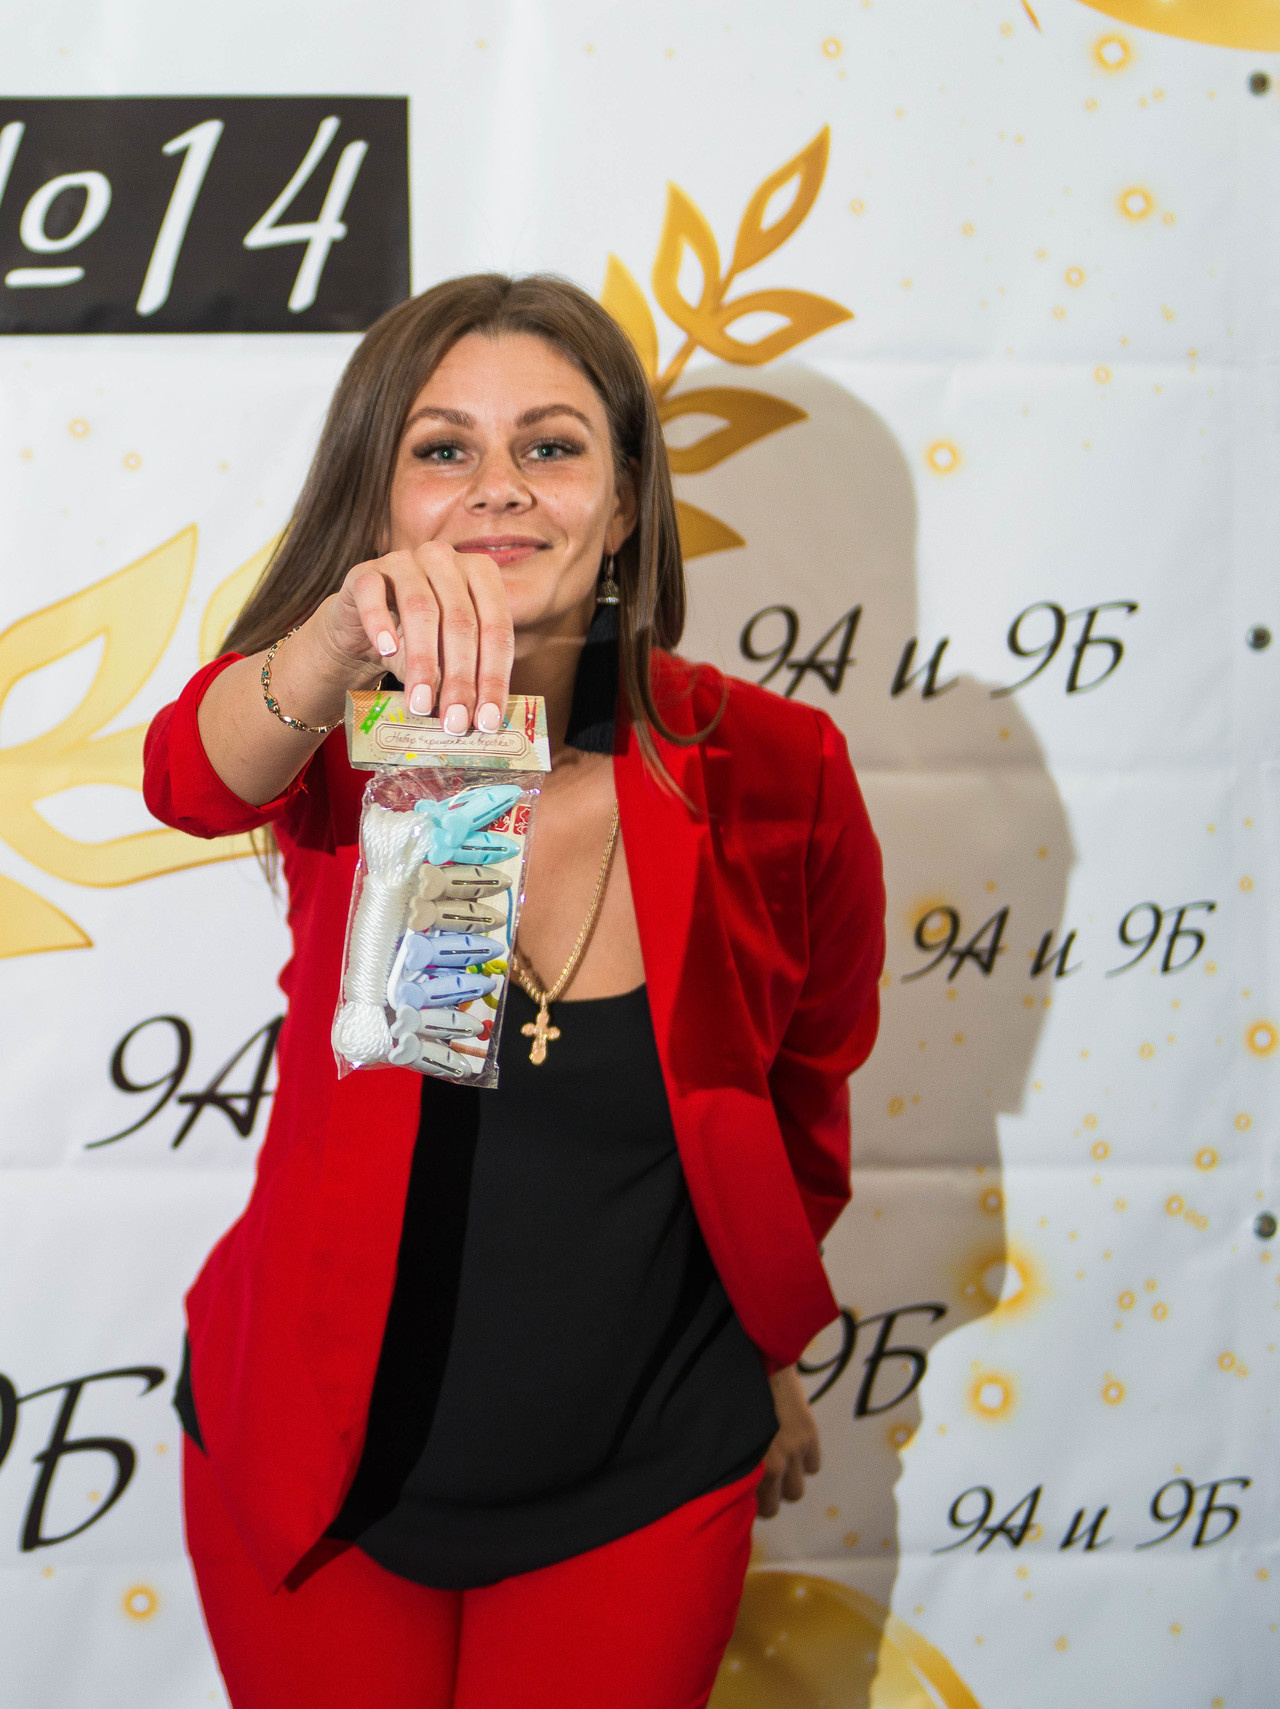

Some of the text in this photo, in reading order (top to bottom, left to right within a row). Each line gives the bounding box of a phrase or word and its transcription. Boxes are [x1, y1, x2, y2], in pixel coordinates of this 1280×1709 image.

[738, 601, 1140, 702] 9А и 9Б
[900, 901, 1217, 983] 9А и 9Б
[83, 1015, 285, 1149] 9А
[796, 1303, 949, 1419] 9Б
[930, 1477, 1253, 1555] 9А и 9Б
